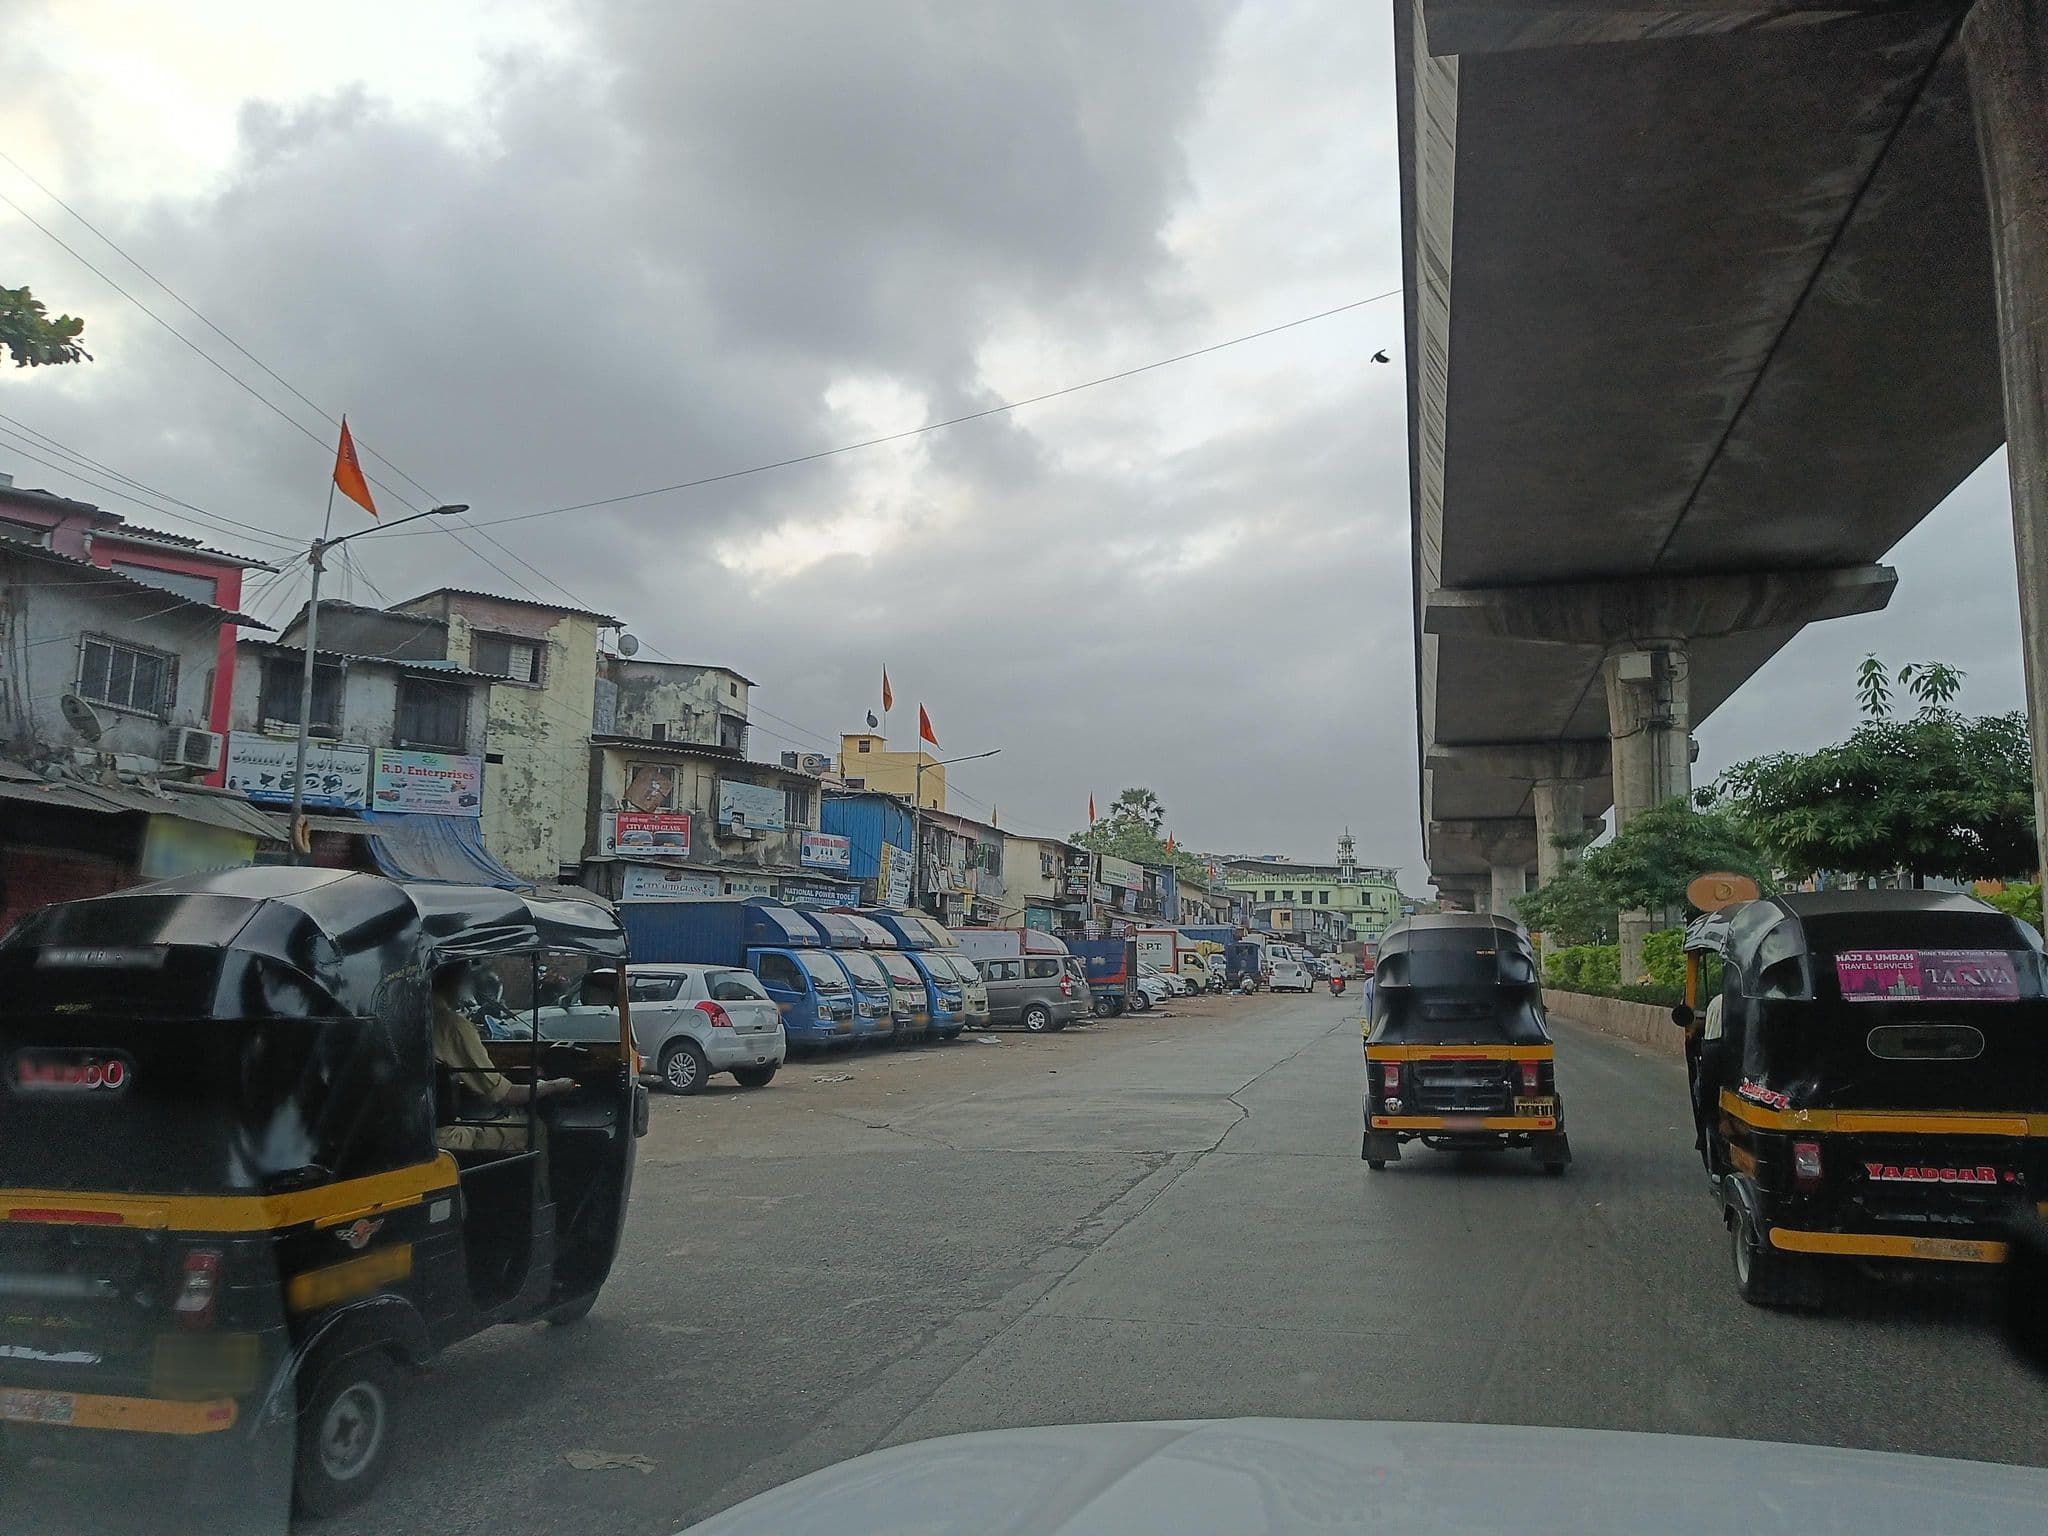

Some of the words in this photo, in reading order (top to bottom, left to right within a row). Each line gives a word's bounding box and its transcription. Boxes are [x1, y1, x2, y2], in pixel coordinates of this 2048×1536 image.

[382, 764, 406, 775] R.D.
[408, 766, 475, 780] Enterprises
[662, 883, 680, 891] AUTO
[680, 884, 702, 893] GLASS
[753, 885, 767, 893] CNG
[784, 887, 814, 897] NATIONAL
[815, 890, 836, 899] POWER
[836, 893, 855, 901] TOOLS
[1138, 943, 1162, 951] S.P.T.
[1836, 954, 1863, 962] HAJJ
[1840, 962, 1872, 970] TRAVEL
[1873, 962, 1914, 970] SERVICES
[1865, 1162, 1998, 1184] YAADGAR
